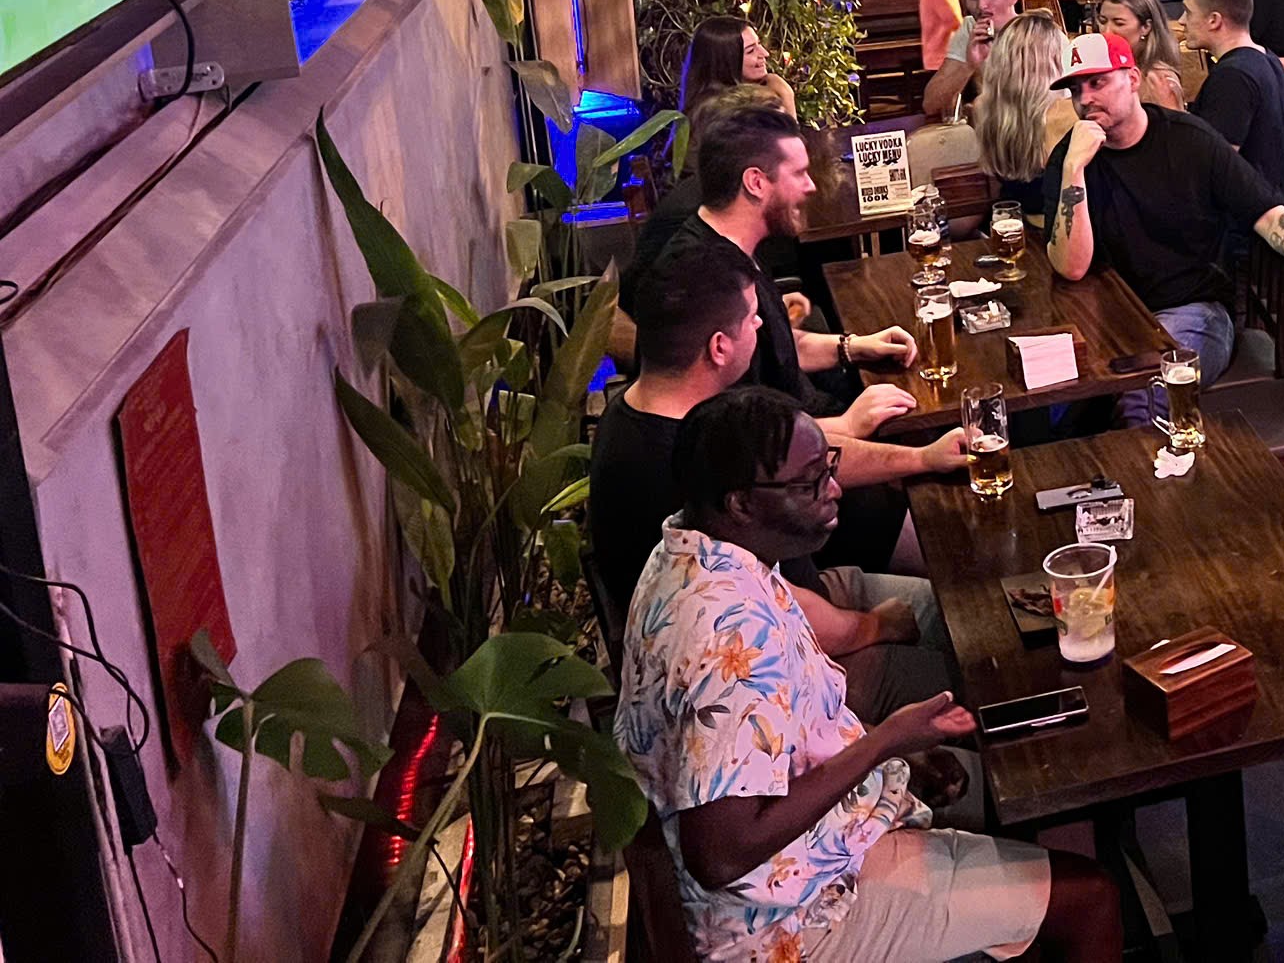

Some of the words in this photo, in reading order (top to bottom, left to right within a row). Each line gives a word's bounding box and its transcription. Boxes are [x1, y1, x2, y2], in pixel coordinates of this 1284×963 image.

[855, 140, 878, 152] LUCKY
[879, 137, 902, 150] VODKA
[859, 150, 880, 163] LUCKY
[882, 148, 902, 160] MENU
[863, 195, 888, 203] 100K
